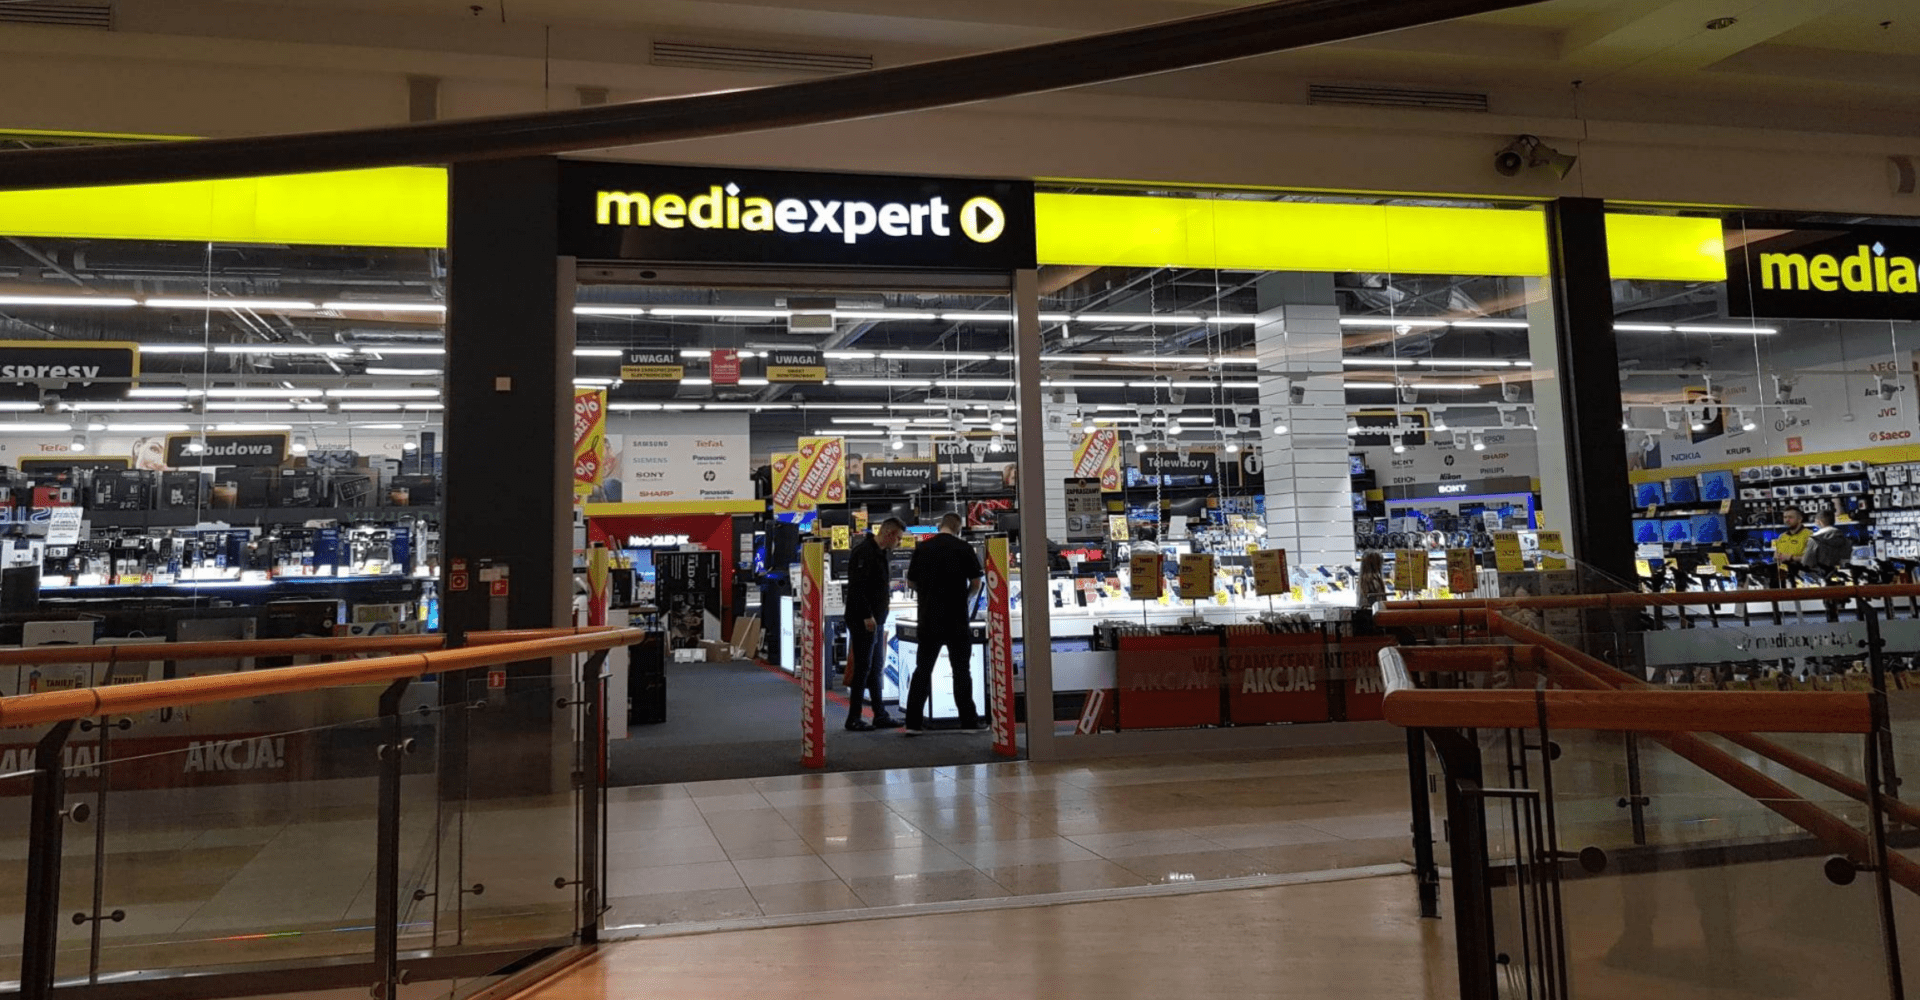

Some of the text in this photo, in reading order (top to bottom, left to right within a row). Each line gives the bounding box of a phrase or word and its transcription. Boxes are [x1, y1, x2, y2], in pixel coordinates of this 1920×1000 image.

[597, 183, 950, 244] mediaexpert
[1760, 242, 1920, 293] media
[631, 354, 674, 363] UWAGA!
[775, 355, 817, 364] UWAGA!
[0, 363, 100, 387] spresy
[1878, 408, 1897, 418] JVC
[1879, 431, 1911, 441] Saeco
[39, 443, 72, 452] Tefa
[180, 442, 274, 457] Zbudowa
[1726, 446, 1752, 455] KRUPS
[1075, 438, 1103, 479] WIELKA
[1147, 456, 1209, 470] Telewizory
[1482, 452, 1509, 461] SHARP
[1672, 452, 1702, 462] NOKIA
[800, 452, 830, 493] WIELKA
[870, 467, 931, 481] Telewizory
[1440, 473, 1462, 481] Nikon
[1480, 466, 1505, 474] PHILIPS
[773, 465, 800, 504] WIELKA
[1438, 484, 1466, 494] SONY
[991, 612, 1009, 747] WYPRZEDAŻ!
[1242, 666, 1317, 693] AKCJA!
[802, 619, 815, 758] WYPRZEDAŻ!
[0, 745, 102, 779] AKJA!
[183, 738, 286, 772] AKCJA!
